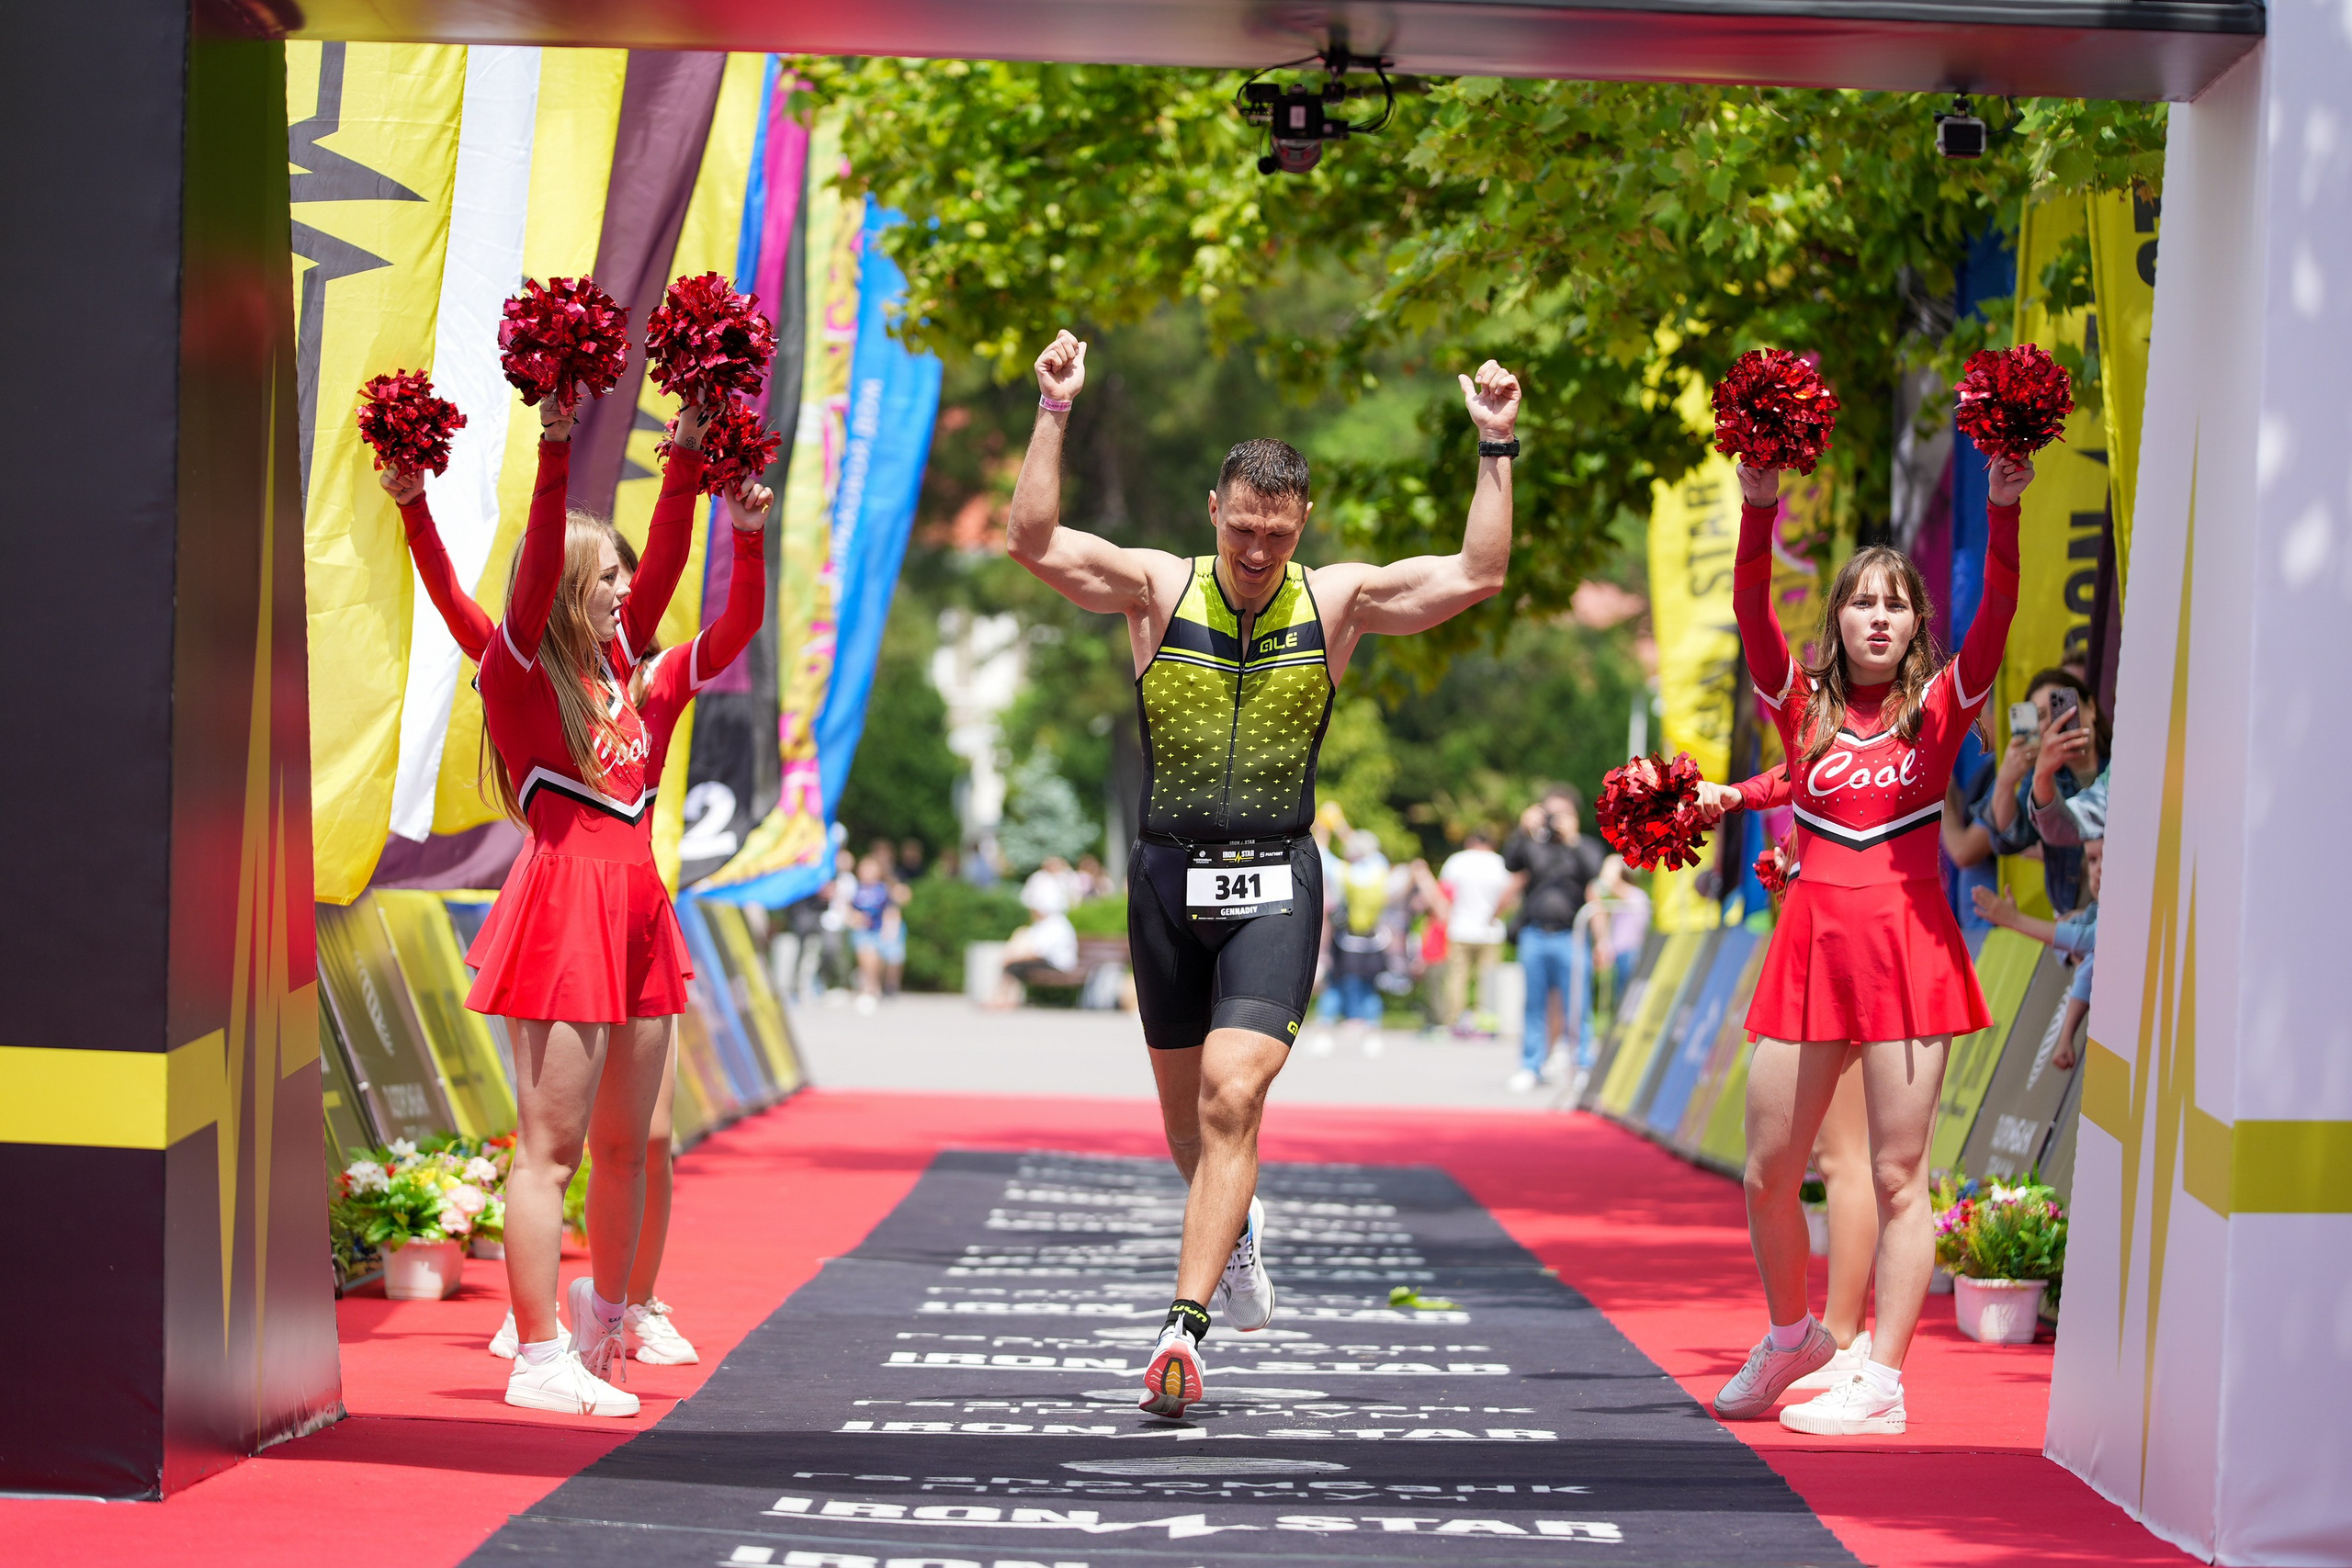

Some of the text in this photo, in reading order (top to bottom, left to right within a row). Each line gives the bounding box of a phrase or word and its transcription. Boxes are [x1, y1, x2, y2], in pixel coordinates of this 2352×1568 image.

[1807, 748, 1917, 796] Cool
[1222, 850, 1255, 859] IRON STAR
[1216, 873, 1261, 900] 341
[1220, 906, 1258, 917] GENNADIY
[888, 1351, 1511, 1374] IRON STAR
[842, 1420, 1559, 1440] IRON STAR
[772, 1496, 1624, 1540] IRON STAR
